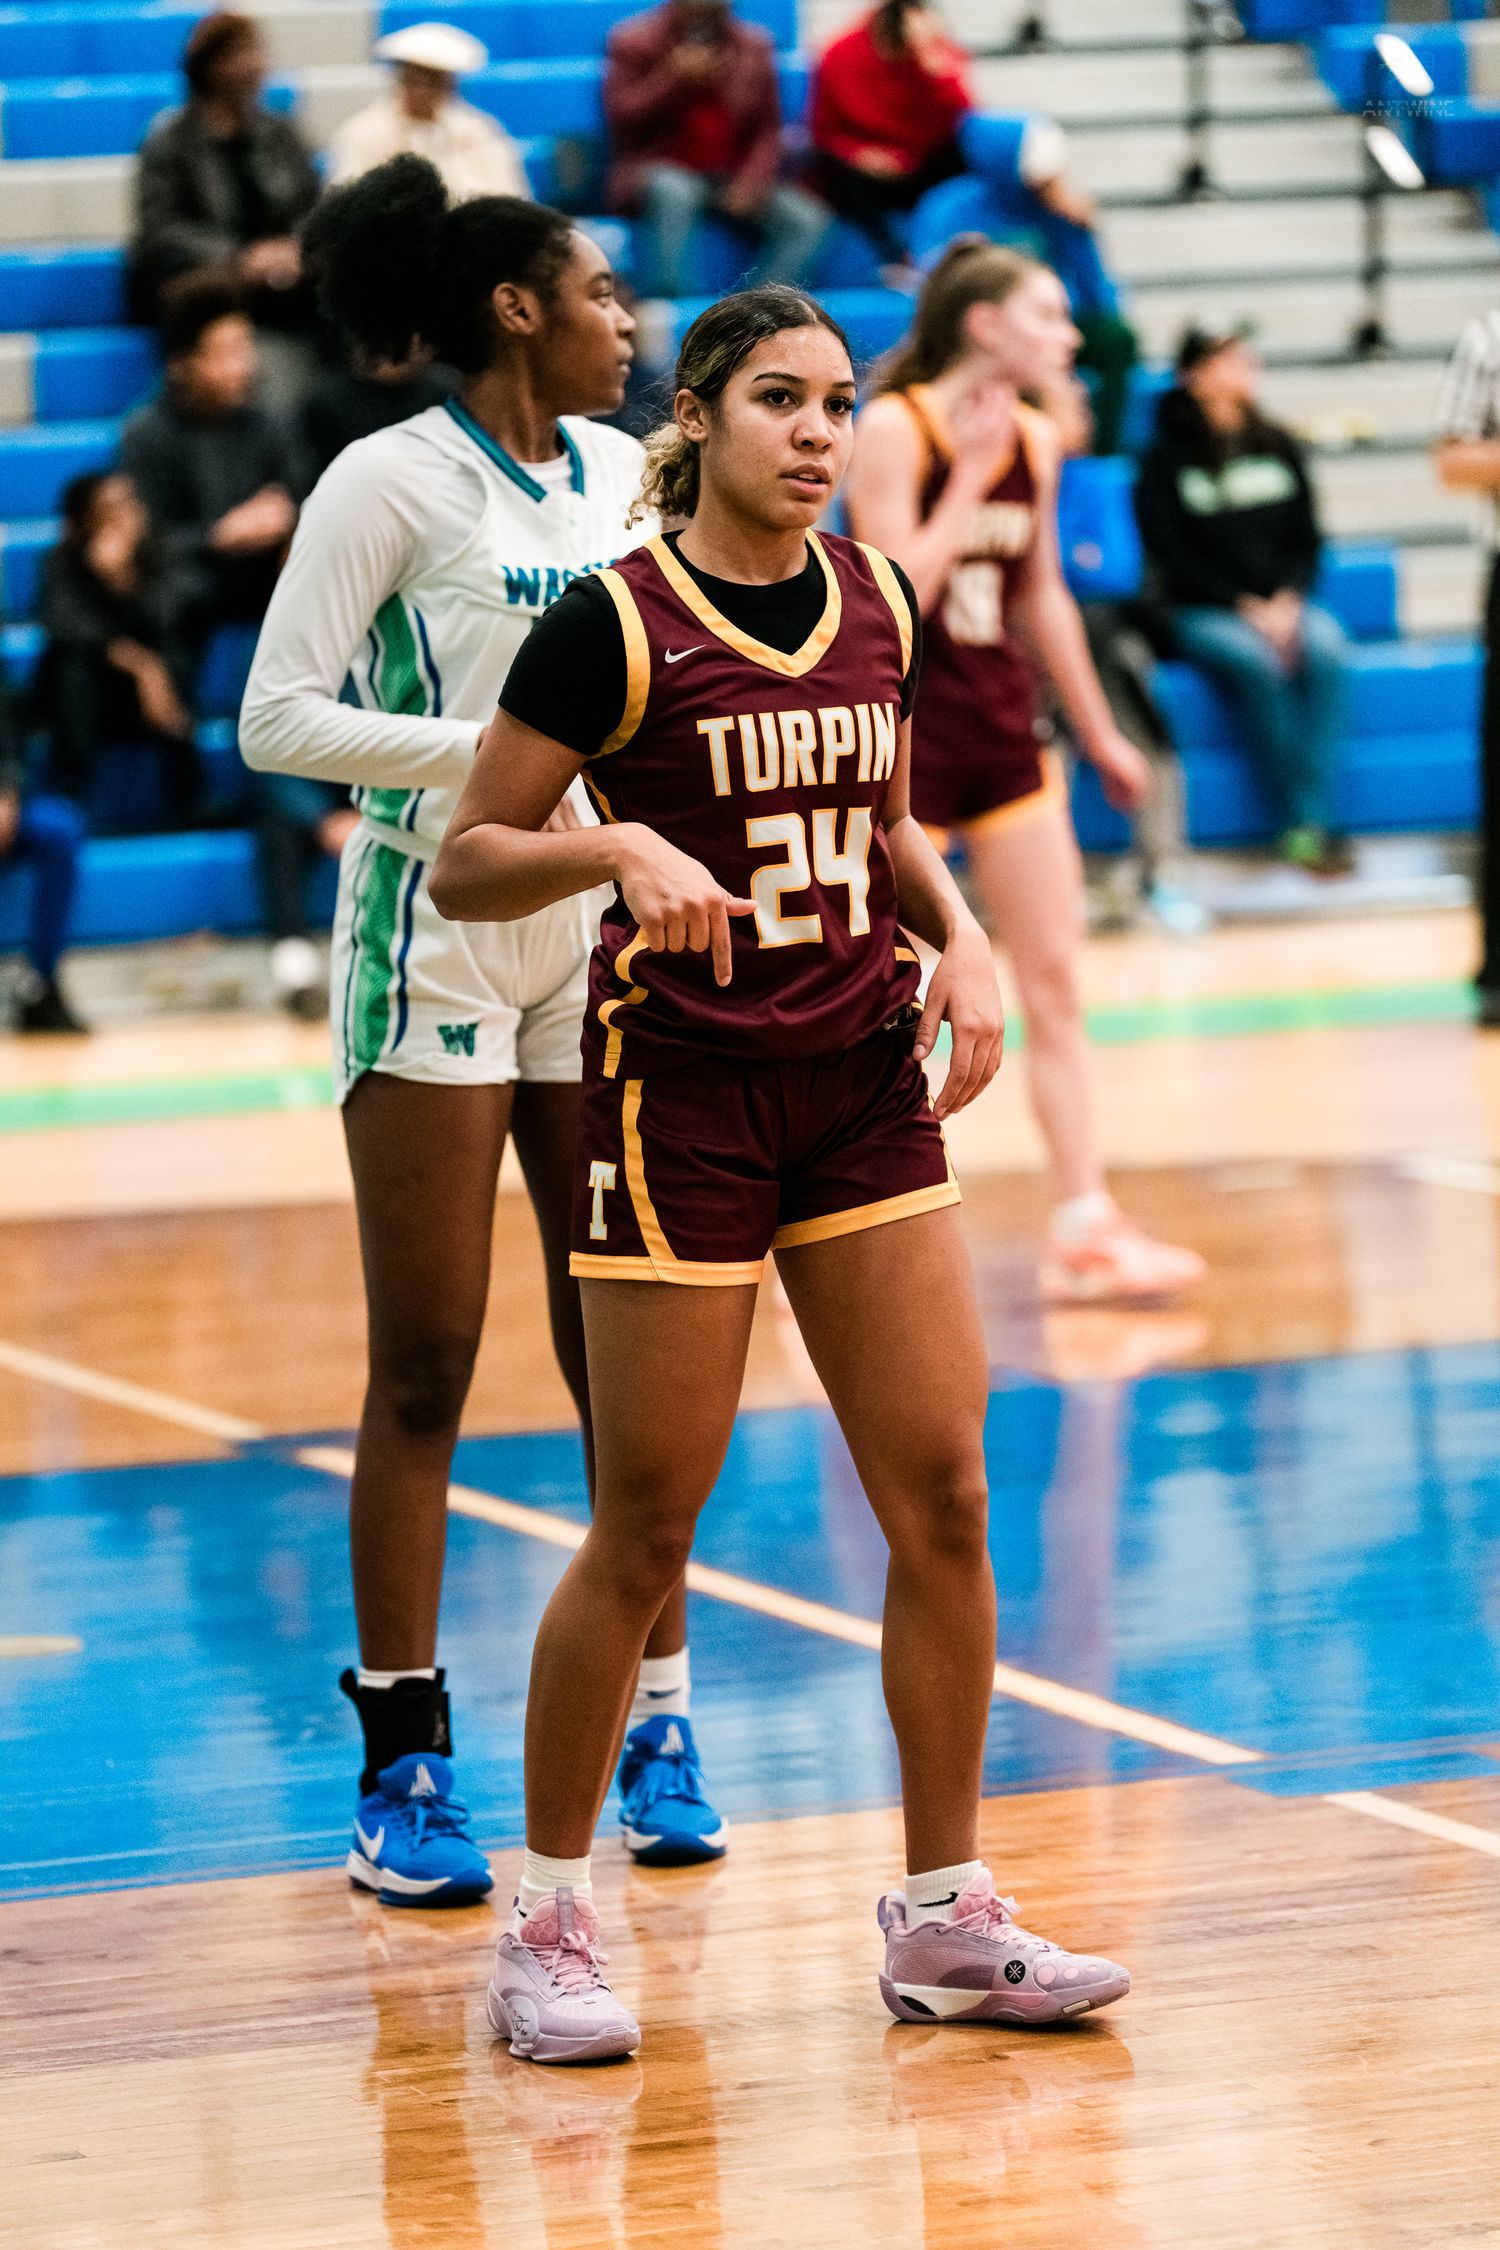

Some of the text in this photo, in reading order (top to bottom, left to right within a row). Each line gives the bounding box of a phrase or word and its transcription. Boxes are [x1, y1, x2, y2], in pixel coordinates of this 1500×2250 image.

[696, 702, 896, 797] TURPIN
[745, 806, 873, 949] 24
[437, 1022, 481, 1057] W
[588, 1160, 617, 1241] T
